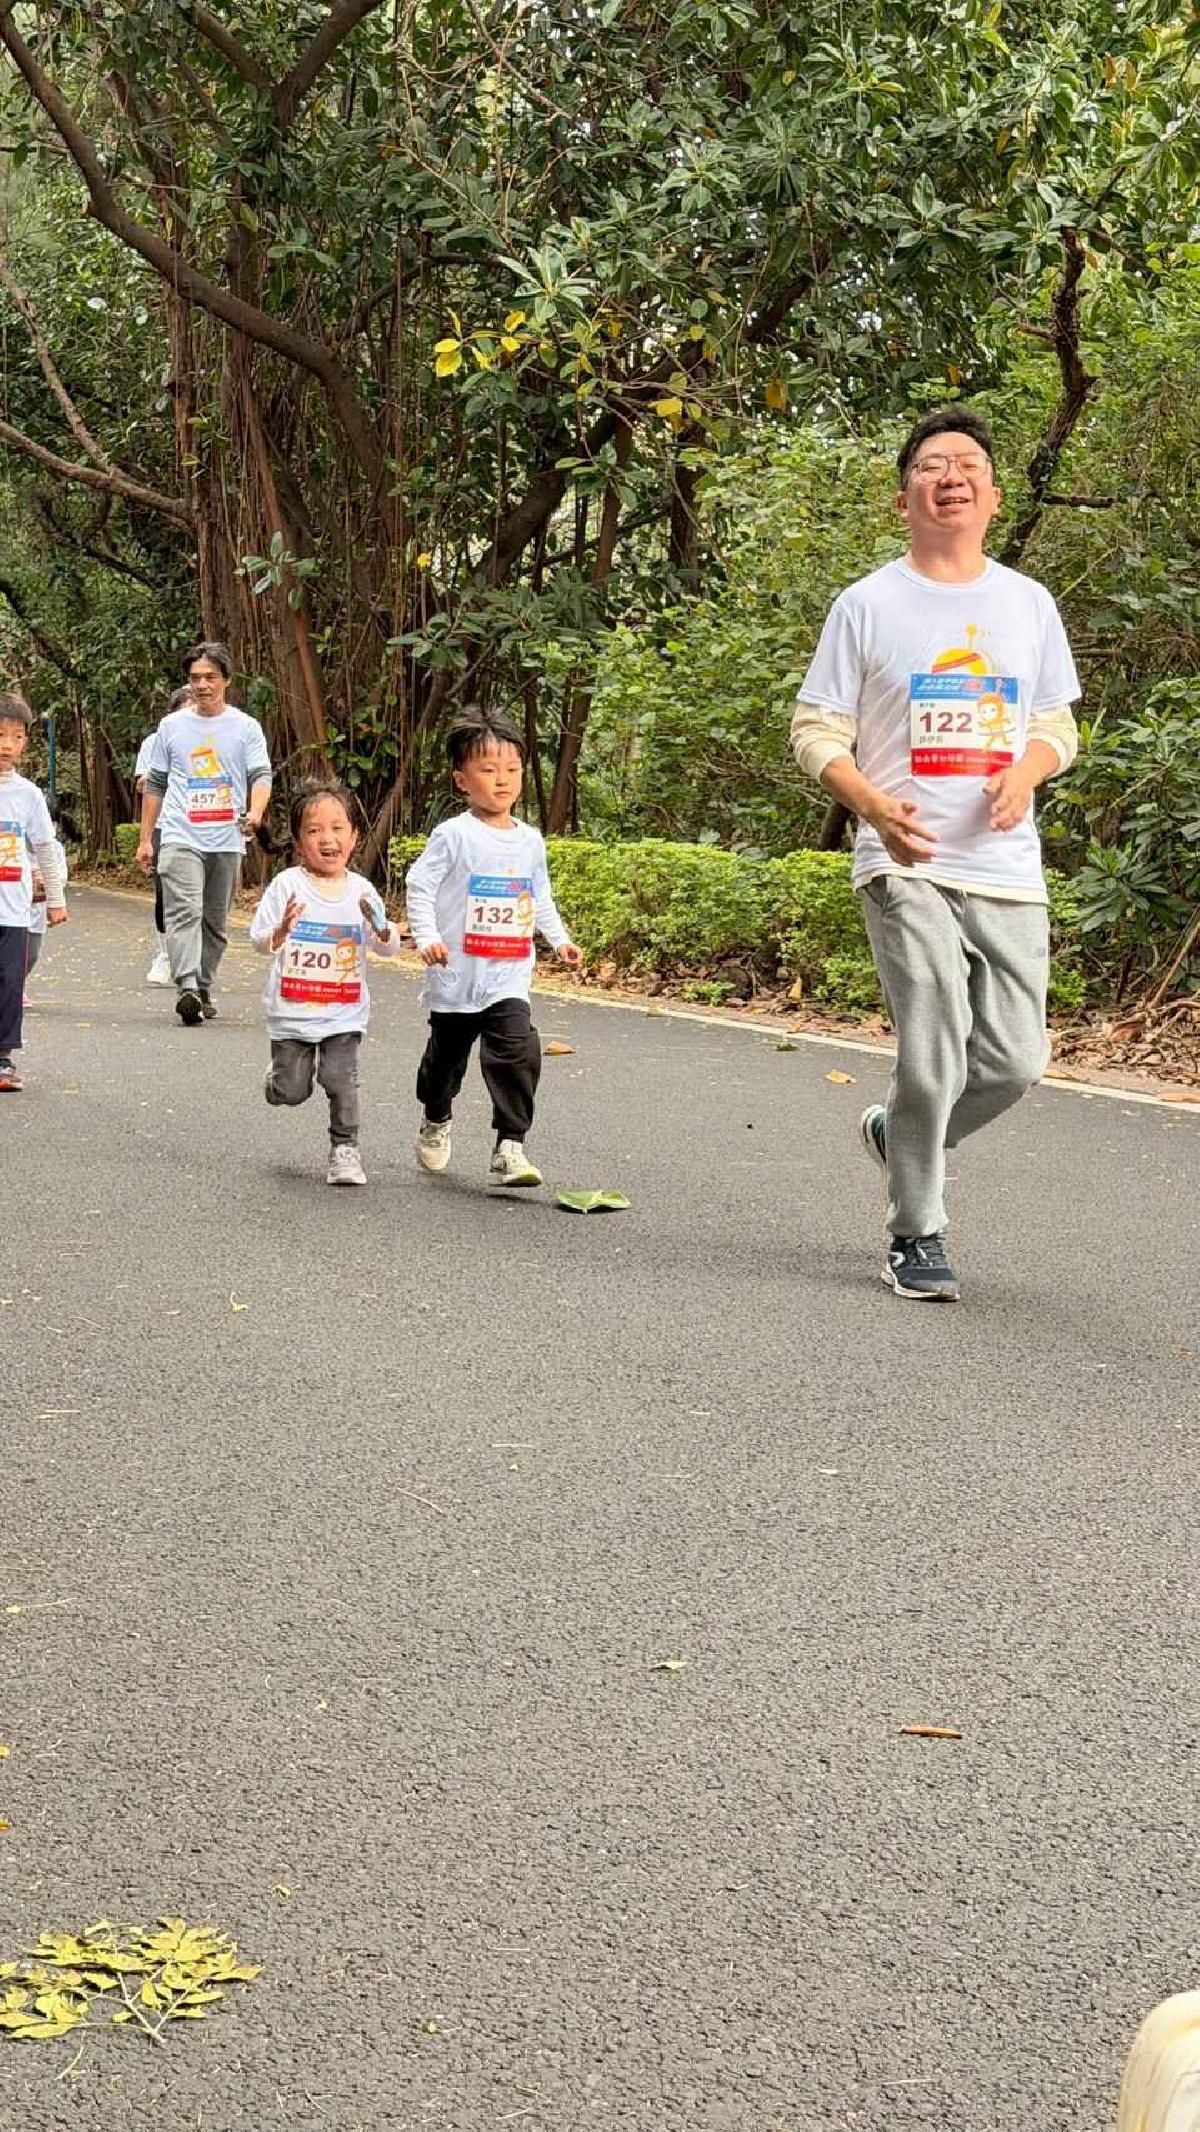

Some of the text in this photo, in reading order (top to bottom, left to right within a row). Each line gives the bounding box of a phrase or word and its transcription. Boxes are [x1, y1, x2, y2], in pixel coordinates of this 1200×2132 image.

[919, 711, 972, 733] 122
[474, 906, 513, 924] 132
[290, 948, 331, 969] 120
